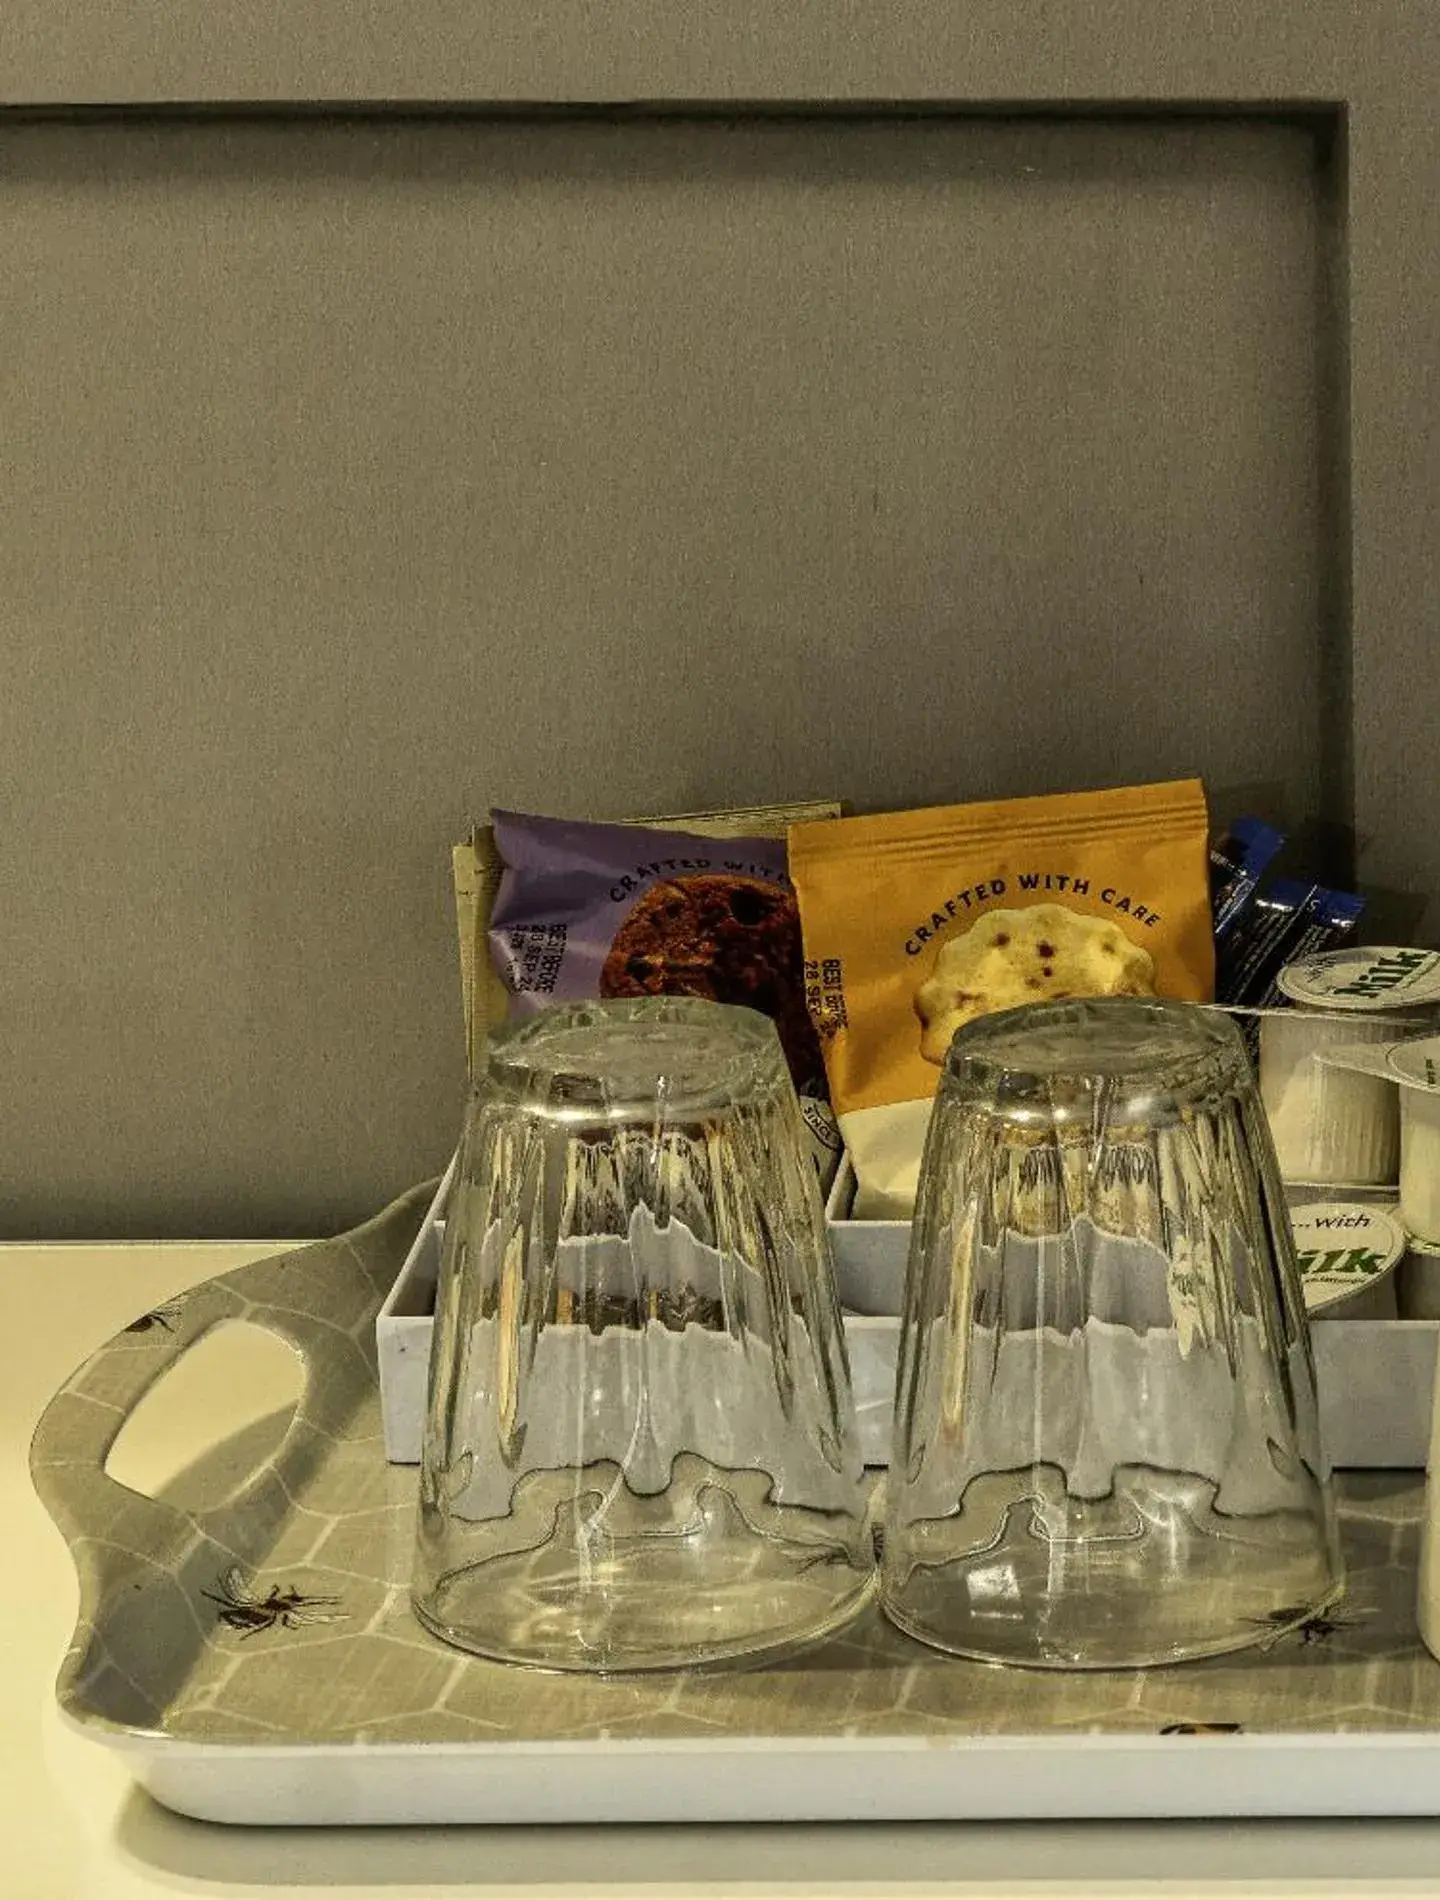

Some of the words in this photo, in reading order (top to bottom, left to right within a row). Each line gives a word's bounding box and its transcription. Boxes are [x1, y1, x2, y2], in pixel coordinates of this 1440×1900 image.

[610, 859, 711, 902] CRAFTED
[905, 878, 1006, 957] CRAFTED
[1018, 874, 1090, 896] WITH
[1100, 888, 1162, 929] CARE
[1297, 1247, 1387, 1275] ilk
